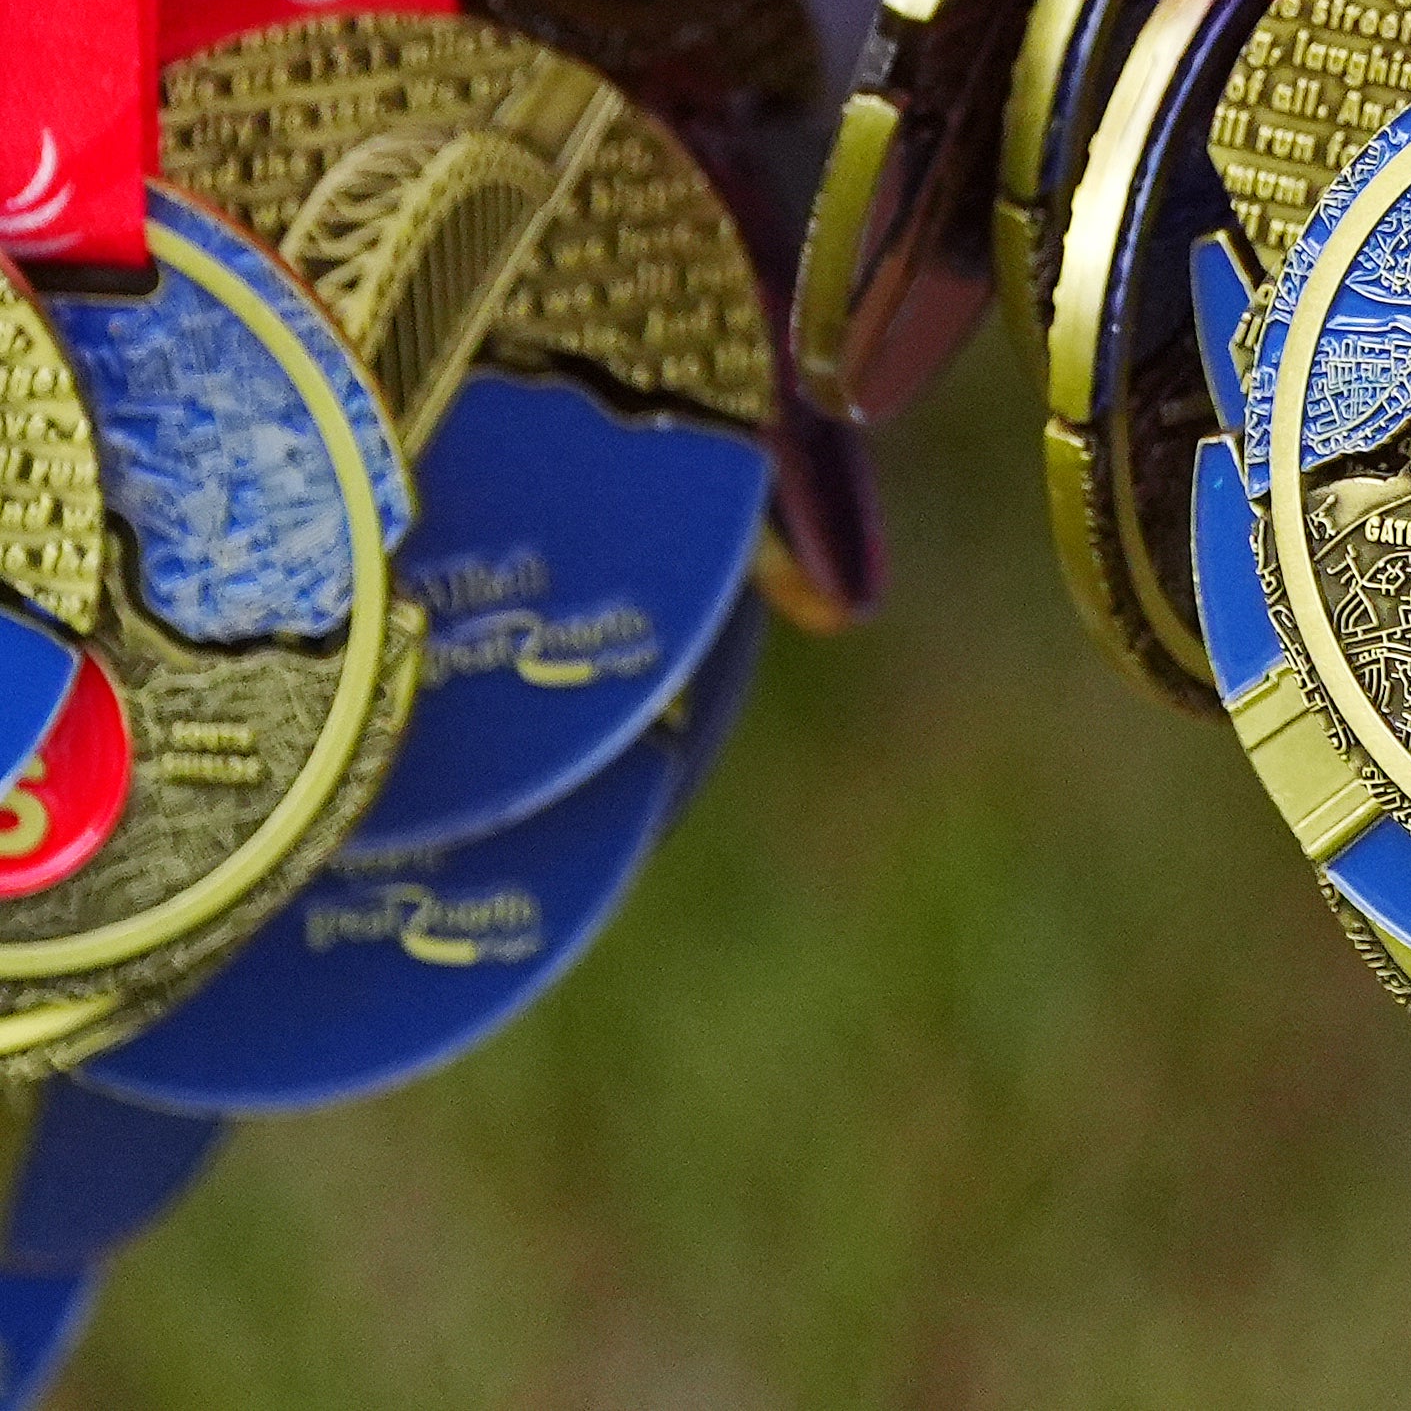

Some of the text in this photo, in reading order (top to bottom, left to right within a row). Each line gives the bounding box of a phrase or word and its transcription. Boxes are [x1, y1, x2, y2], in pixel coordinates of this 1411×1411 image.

[1226, 67, 1267, 106] of
[1271, 76, 1330, 120] all.
[1255, 124, 1317, 165] run
